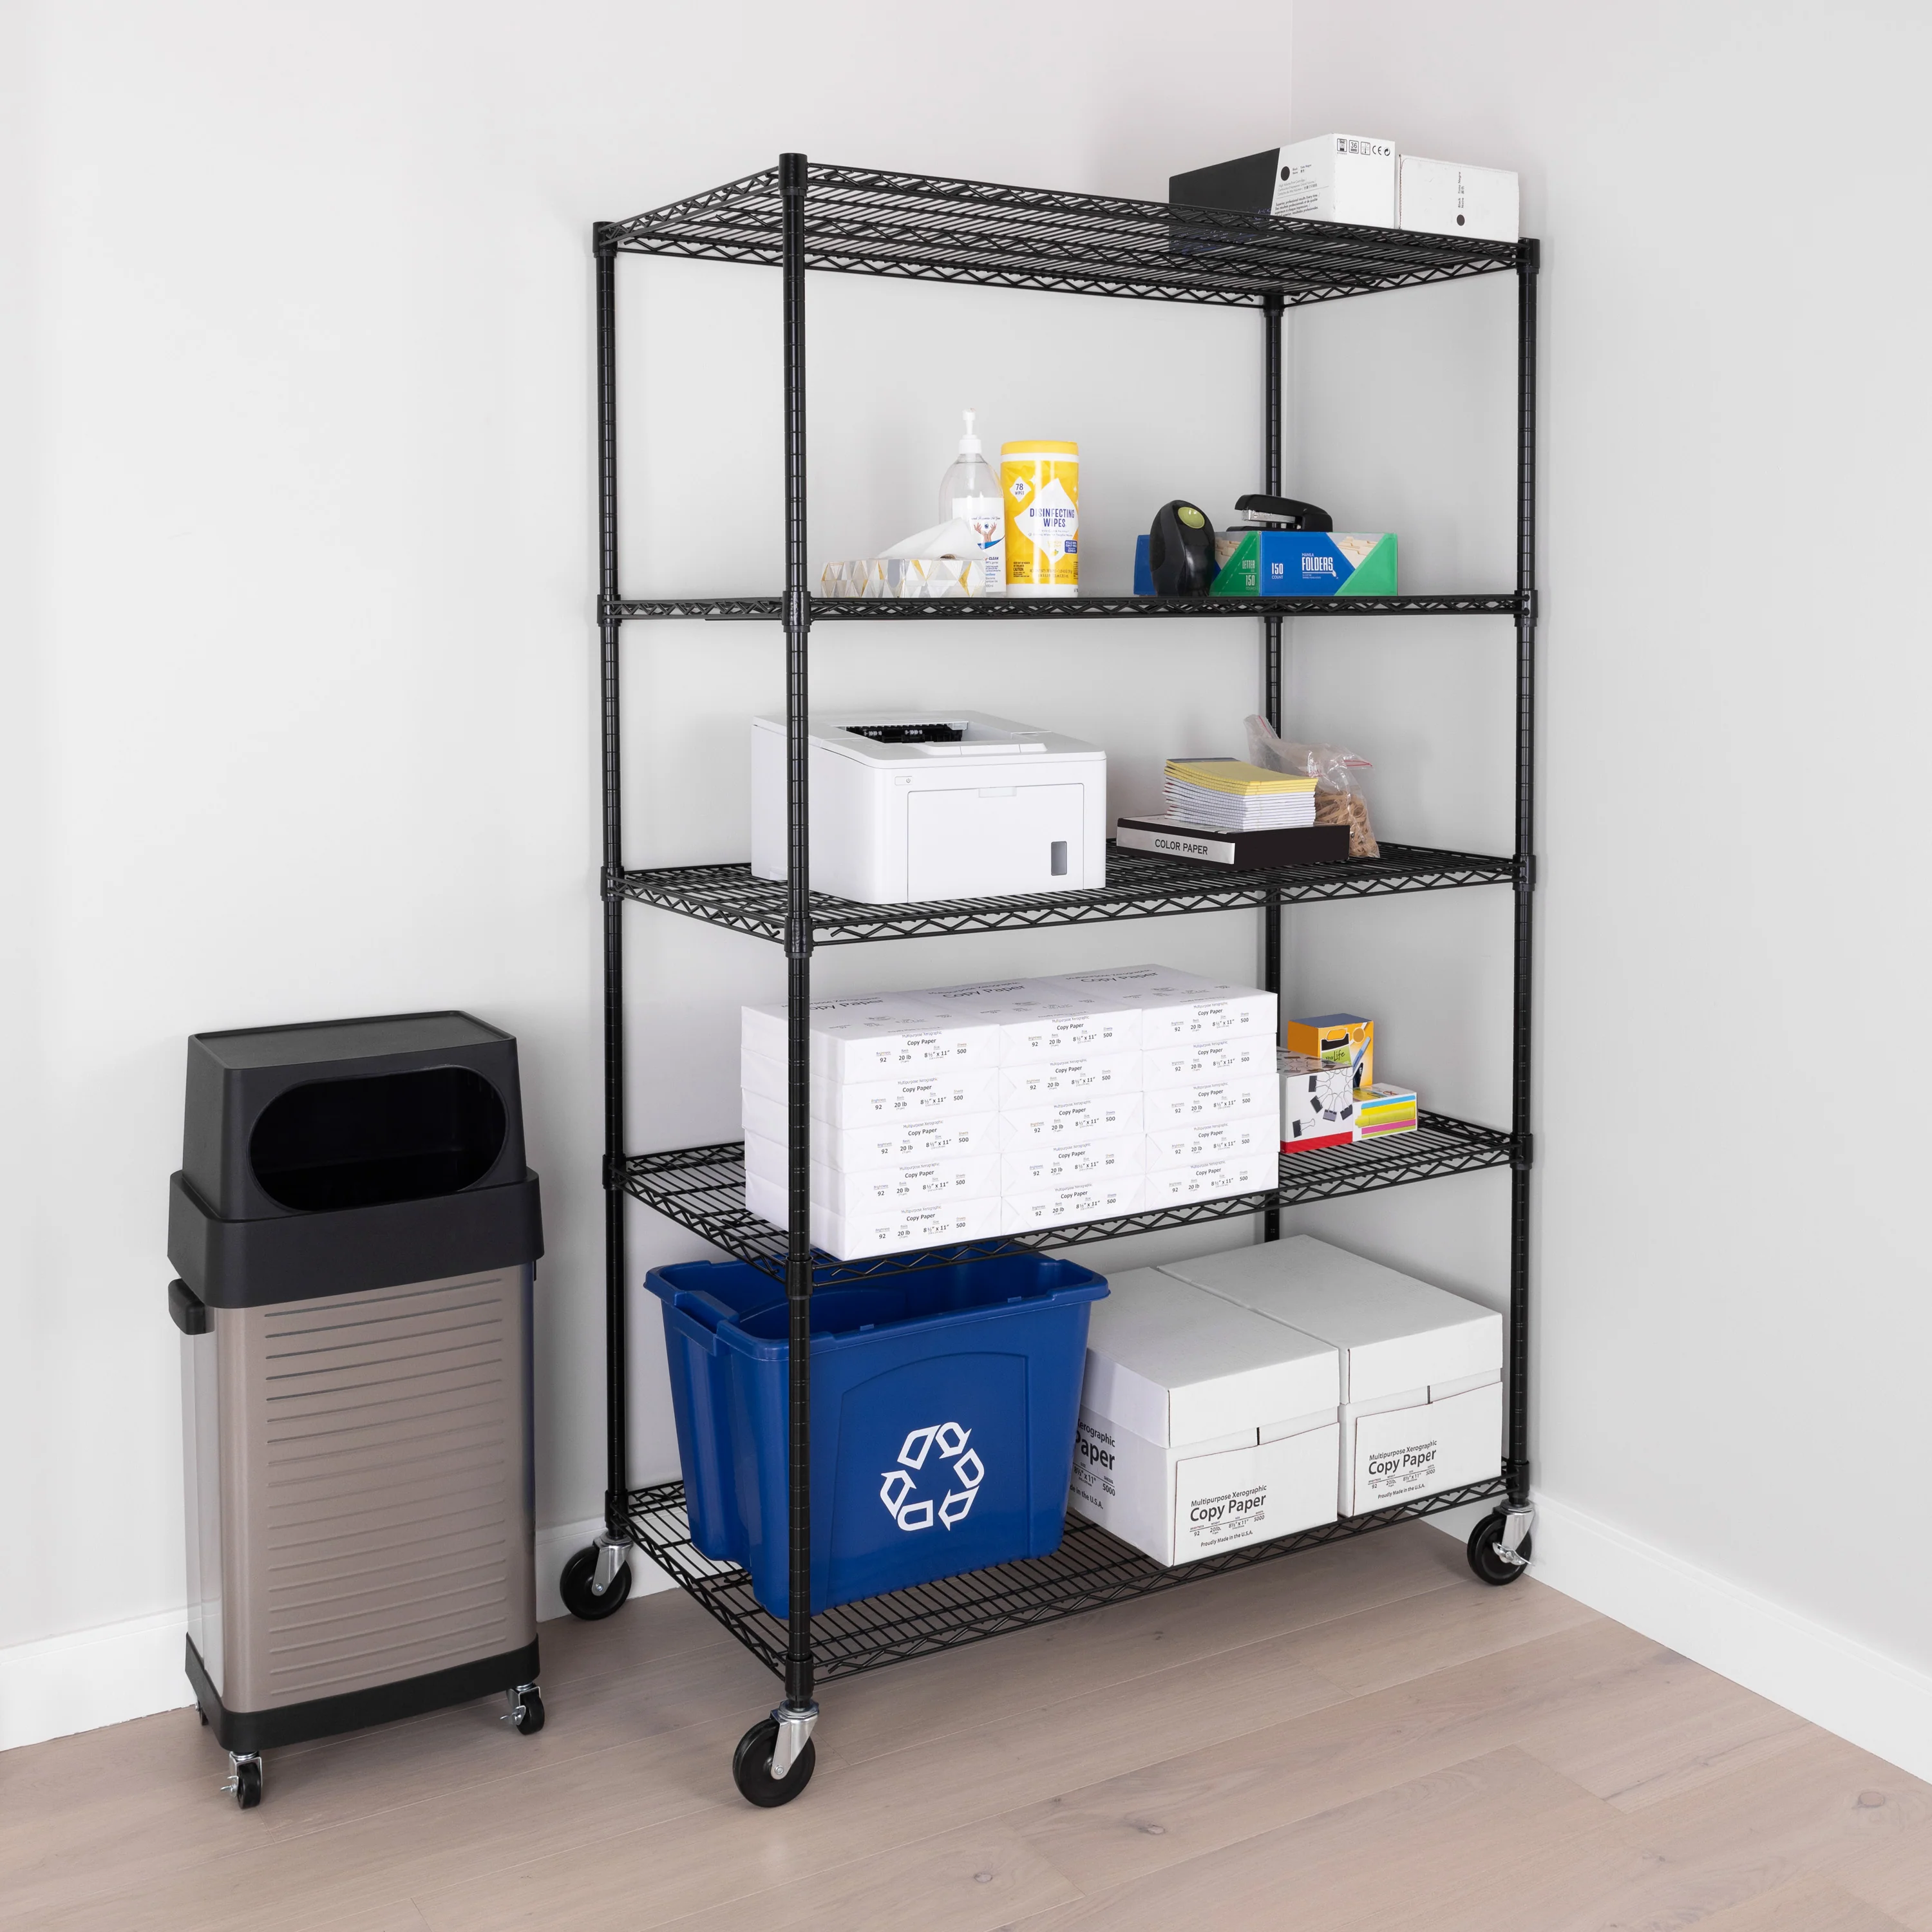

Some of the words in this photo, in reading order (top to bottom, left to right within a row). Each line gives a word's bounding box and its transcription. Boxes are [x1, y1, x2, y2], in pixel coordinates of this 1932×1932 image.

[1372, 146, 1381, 155] CE
[1030, 508, 1074, 518] DISINFECTING
[1043, 518, 1065, 527] WIPES
[1242, 560, 1255, 569] LETTER
[1272, 563, 1283, 574] 150
[1302, 557, 1333, 571] FOLDERS
[1245, 575, 1255, 586] 150
[1155, 838, 1180, 851] COLOR
[1183, 843, 1208, 855] PAPER
[1334, 1049, 1345, 1061] Life
[1369, 1448, 1405, 1461] Multipurpose
[1406, 1440, 1437, 1452] Xerographic
[1368, 1459, 1400, 1475] Copy
[1403, 1450, 1436, 1467] Paper
[1103, 1484, 1115, 1496] 5000
[1191, 1494, 1231, 1507] Multipurpose
[1232, 1485, 1267, 1498] Xerographic
[1090, 1496, 1104, 1510] U.S.A.
[1190, 1504, 1225, 1521] Copy
[1229, 1495, 1266, 1513] Paper
[1201, 1539, 1217, 1547] Proudly
